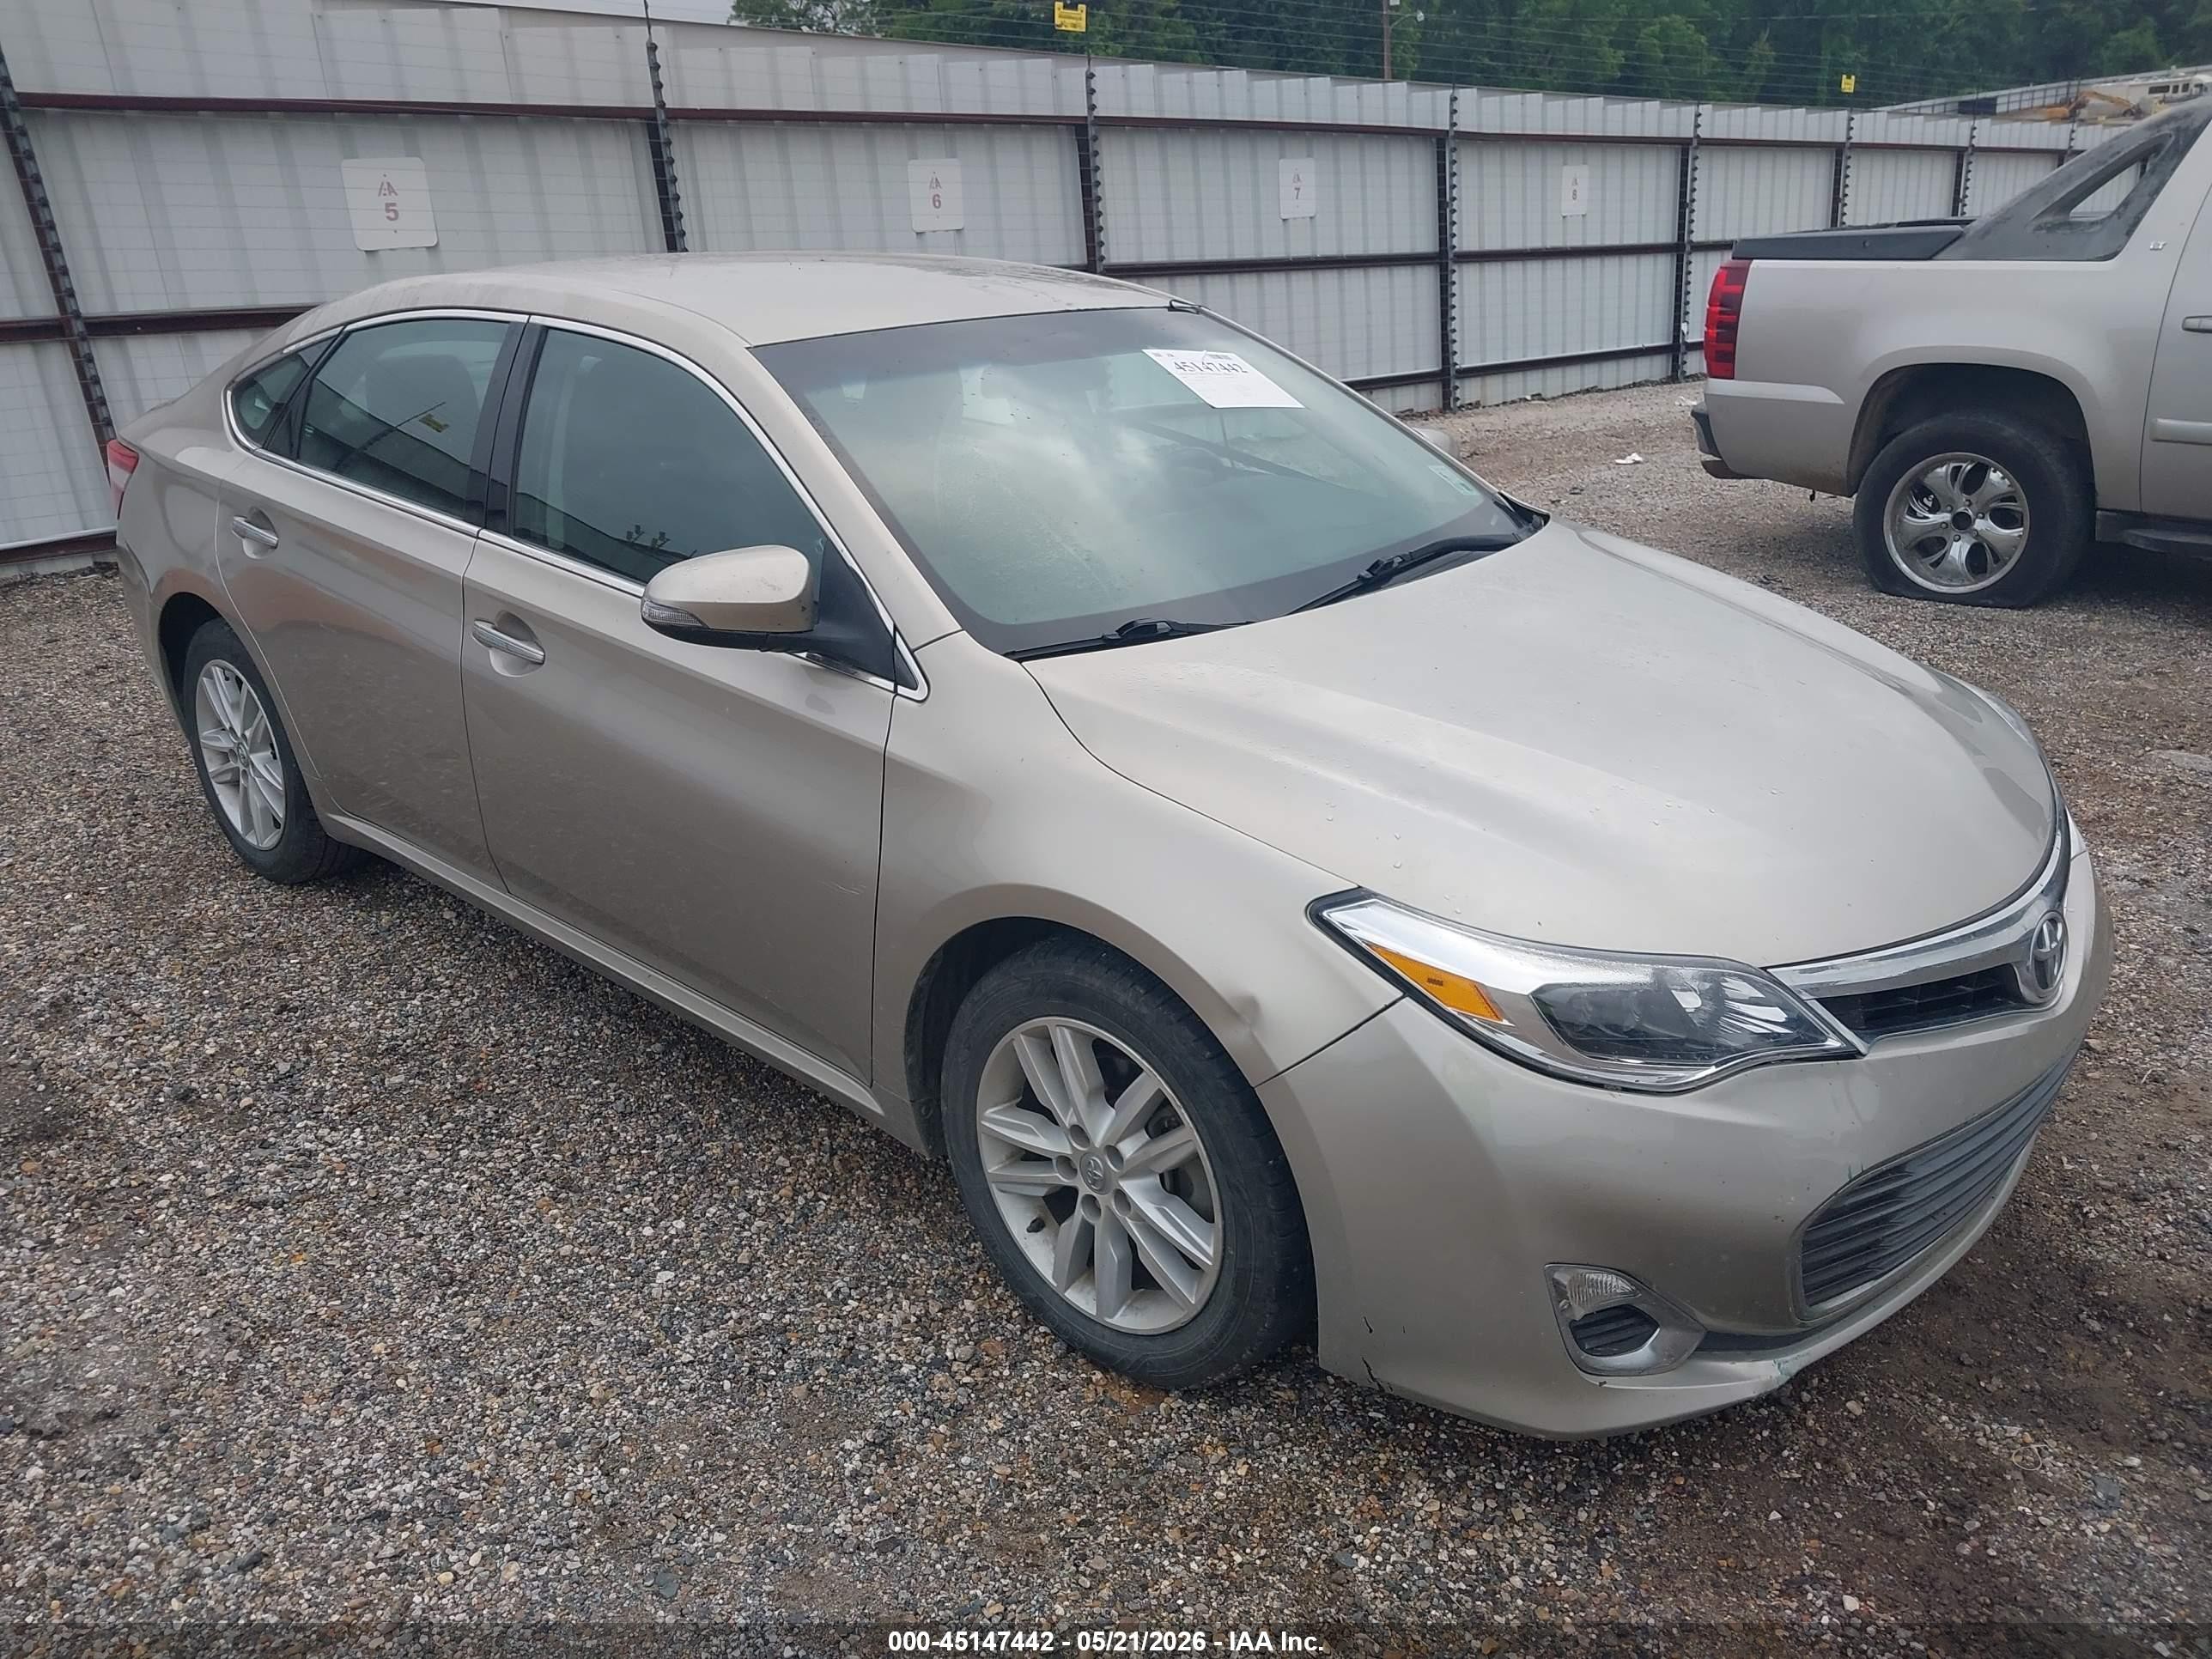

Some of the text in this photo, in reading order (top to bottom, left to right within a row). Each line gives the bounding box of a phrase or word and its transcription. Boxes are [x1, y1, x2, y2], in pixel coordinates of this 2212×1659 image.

[1294, 187, 1301, 200] 7
[933, 193, 942, 210] 6
[385, 202, 399, 222] 5
[1173, 361, 1249, 374] 45147442
